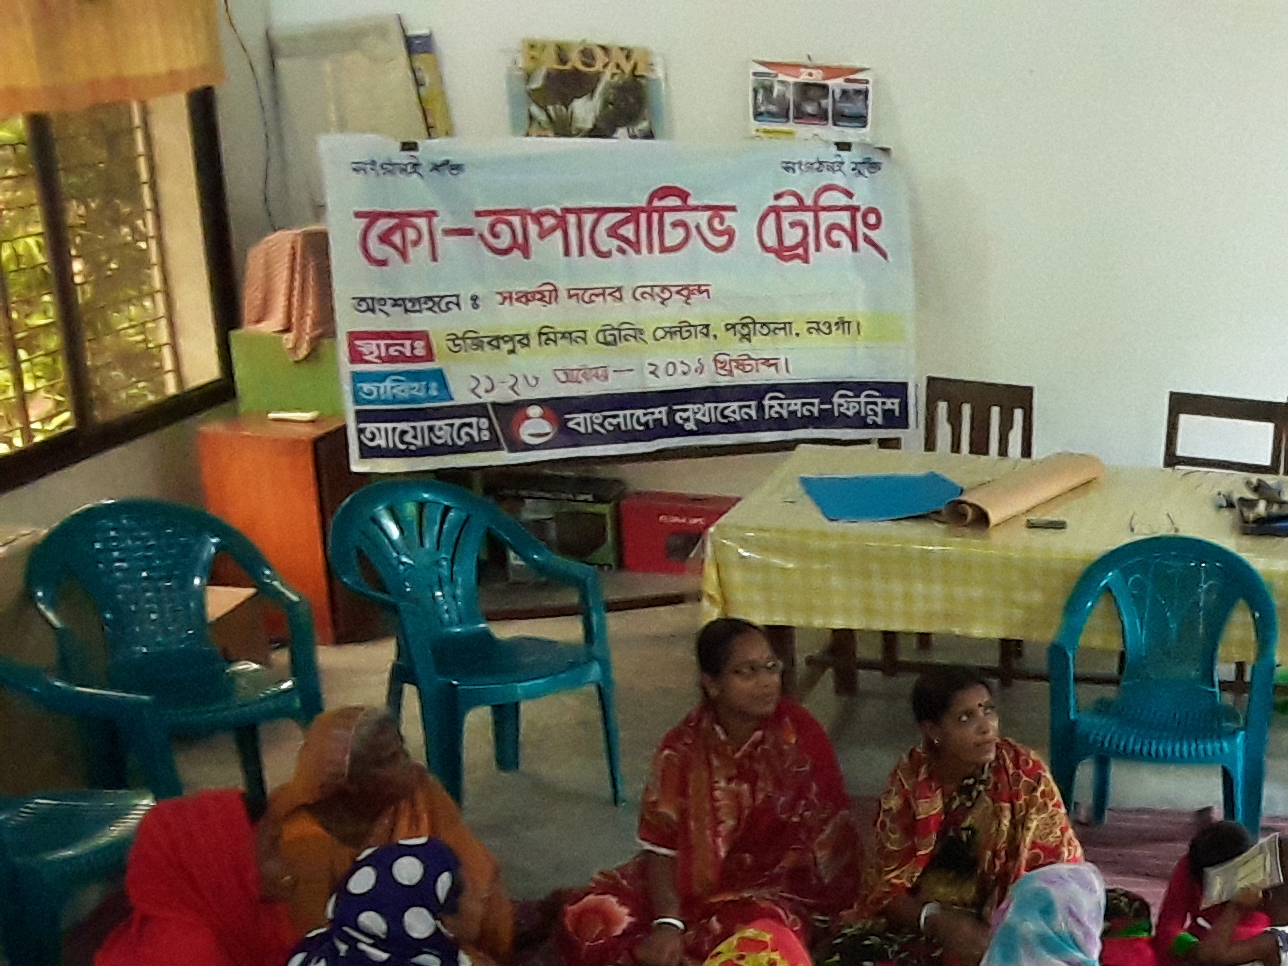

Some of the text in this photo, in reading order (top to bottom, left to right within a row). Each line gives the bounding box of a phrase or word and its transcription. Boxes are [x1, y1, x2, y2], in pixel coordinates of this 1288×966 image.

[352, 183, 890, 268] কো-অপারেটিভ ট্রেনিং
[567, 286, 623, 306] দলের
[632, 283, 712, 307] নেতৃবৃন্দ
[445, 330, 530, 355] উজিরপুর
[538, 326, 588, 346] মিশন
[596, 322, 649, 346] ট্রেনিং
[564, 403, 669, 436] বাংলাদেশ
[673, 399, 757, 431] লুথারেন
